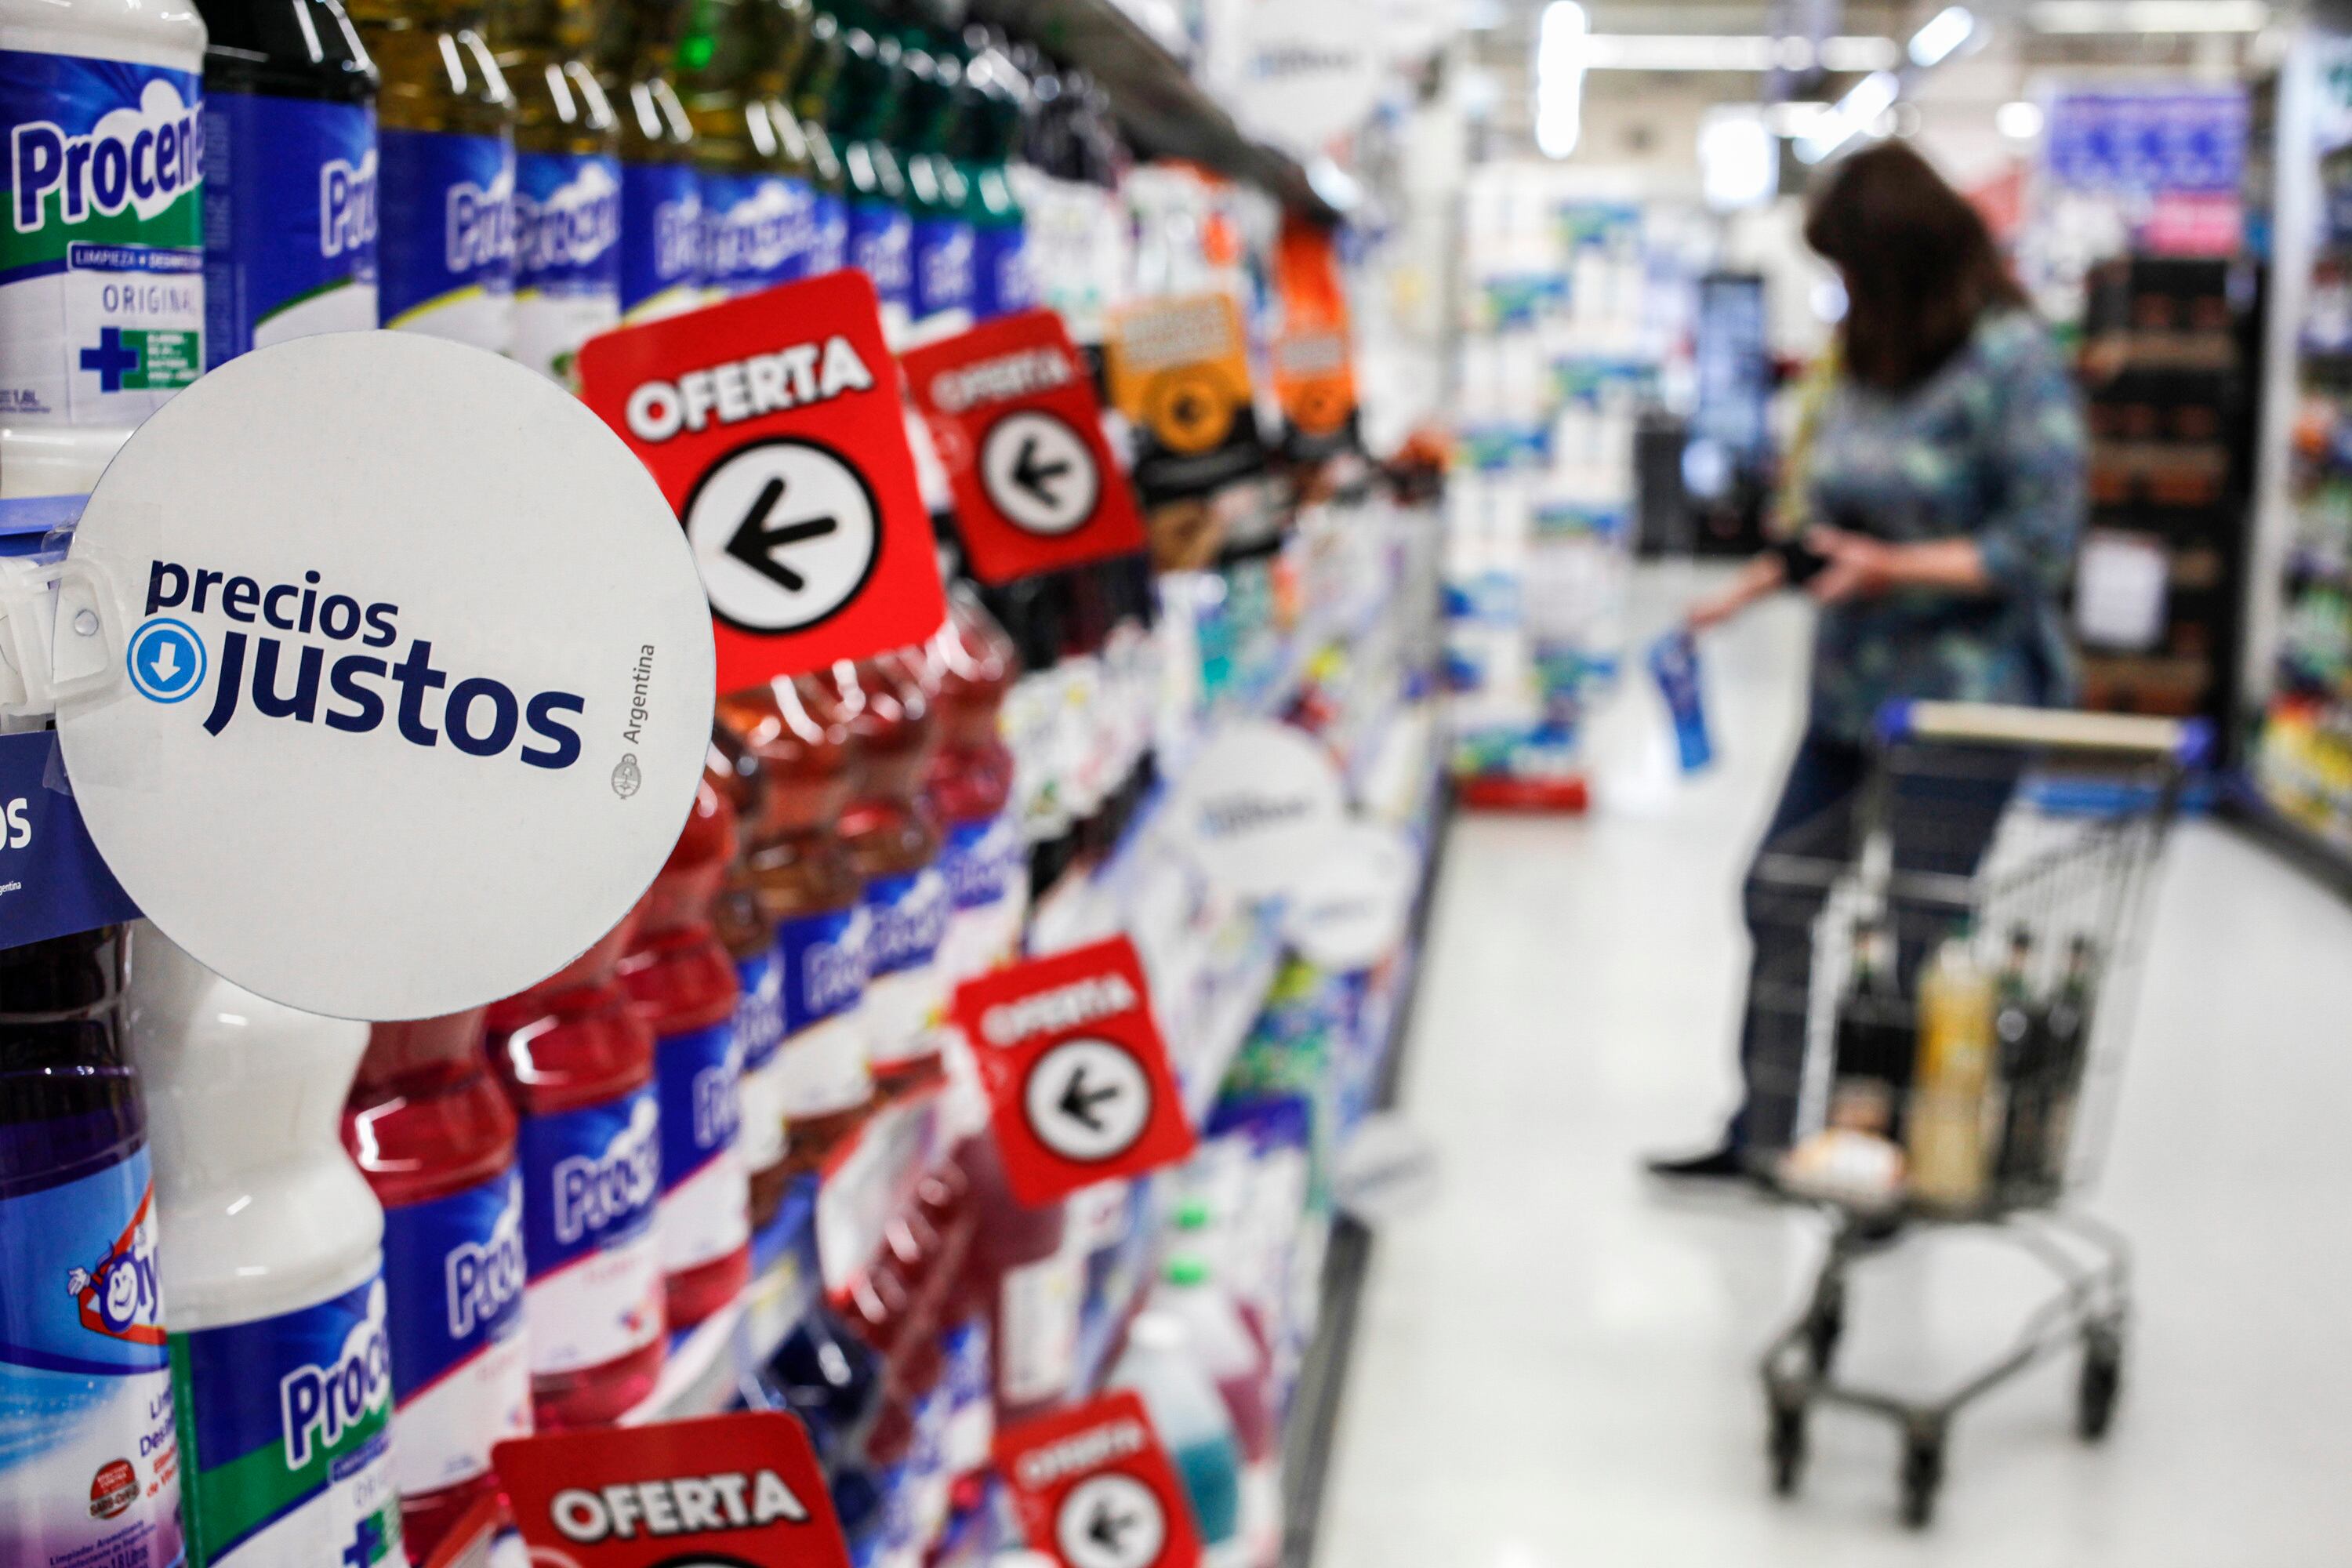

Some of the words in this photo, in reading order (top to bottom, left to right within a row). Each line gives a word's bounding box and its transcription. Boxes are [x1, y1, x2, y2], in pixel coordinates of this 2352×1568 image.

[625, 335, 874, 442] OFERTA
[144, 559, 399, 648] precios
[202, 630, 586, 769] justos
[623, 644, 655, 745] Argentina
[981, 973, 1136, 1048] OFERTA
[550, 1468, 810, 1543] OFERTA
